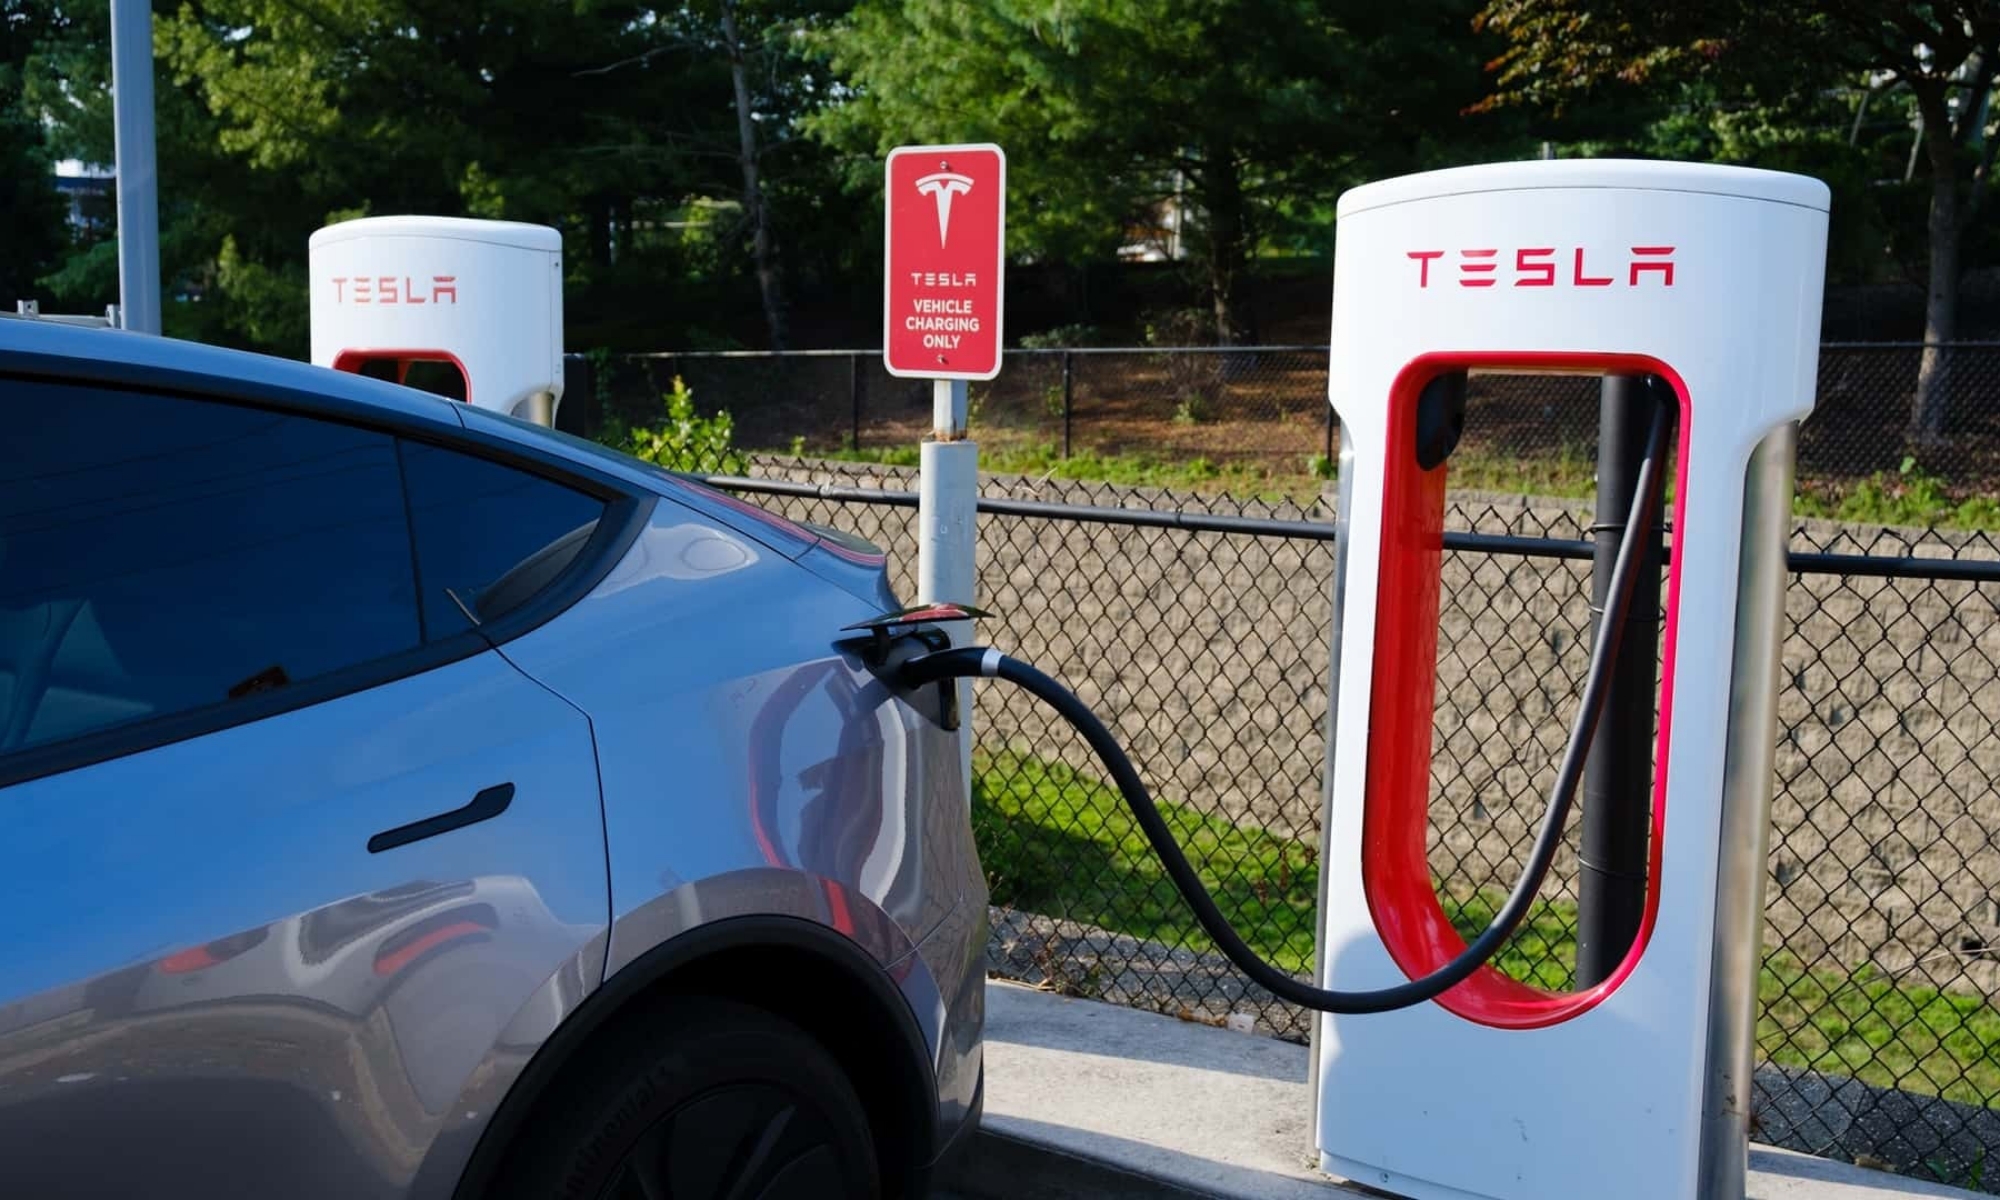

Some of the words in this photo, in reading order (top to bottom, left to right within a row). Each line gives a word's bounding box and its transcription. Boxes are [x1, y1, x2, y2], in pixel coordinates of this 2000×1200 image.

[1407, 246, 1675, 288] TESLA
[910, 272, 977, 287] TESLA
[332, 275, 457, 305] TESLA
[913, 299, 973, 315] VEHICLE
[905, 316, 980, 332] CHARGING
[923, 333, 961, 349] ONLY
